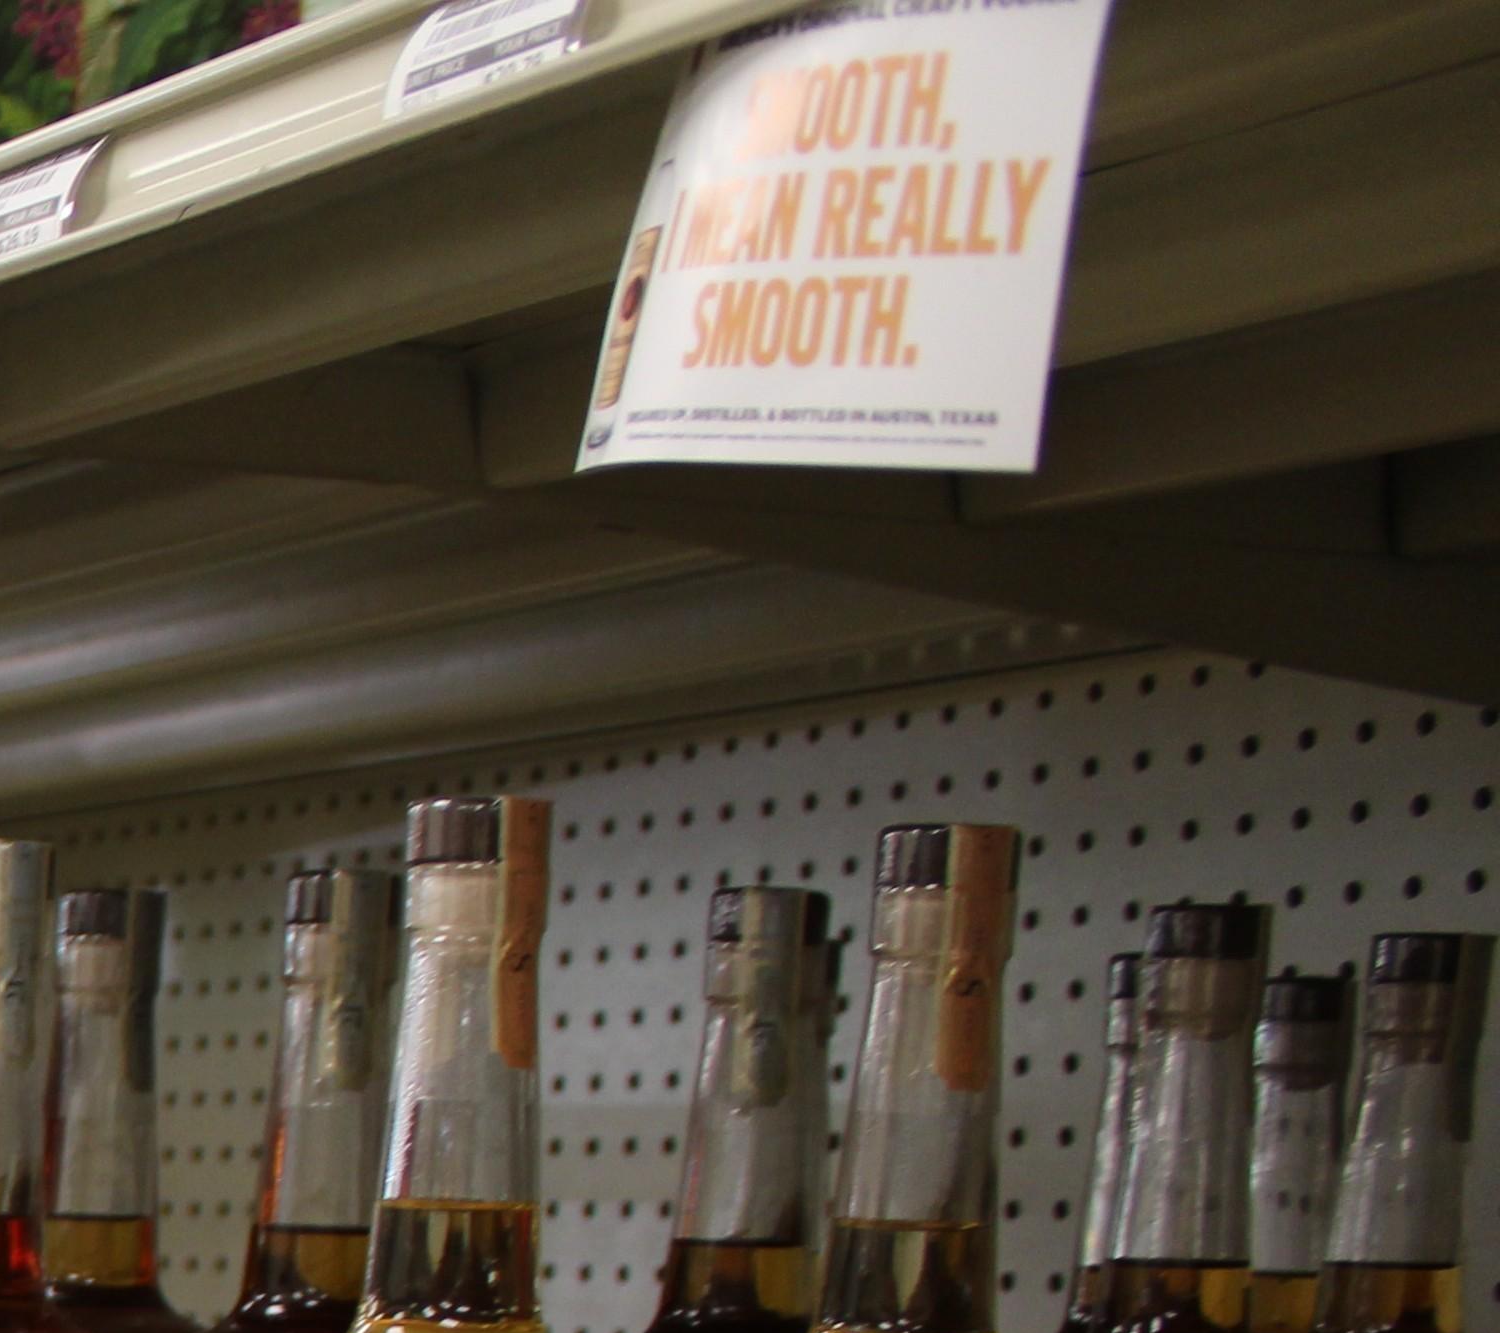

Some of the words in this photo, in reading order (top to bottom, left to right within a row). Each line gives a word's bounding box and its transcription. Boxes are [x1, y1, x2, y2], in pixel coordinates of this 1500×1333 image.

[681, 169, 808, 270] MEAN
[812, 157, 1053, 260] REALLY
[682, 274, 920, 370] SMOOTH.
[939, 409, 999, 426] TEXAS
